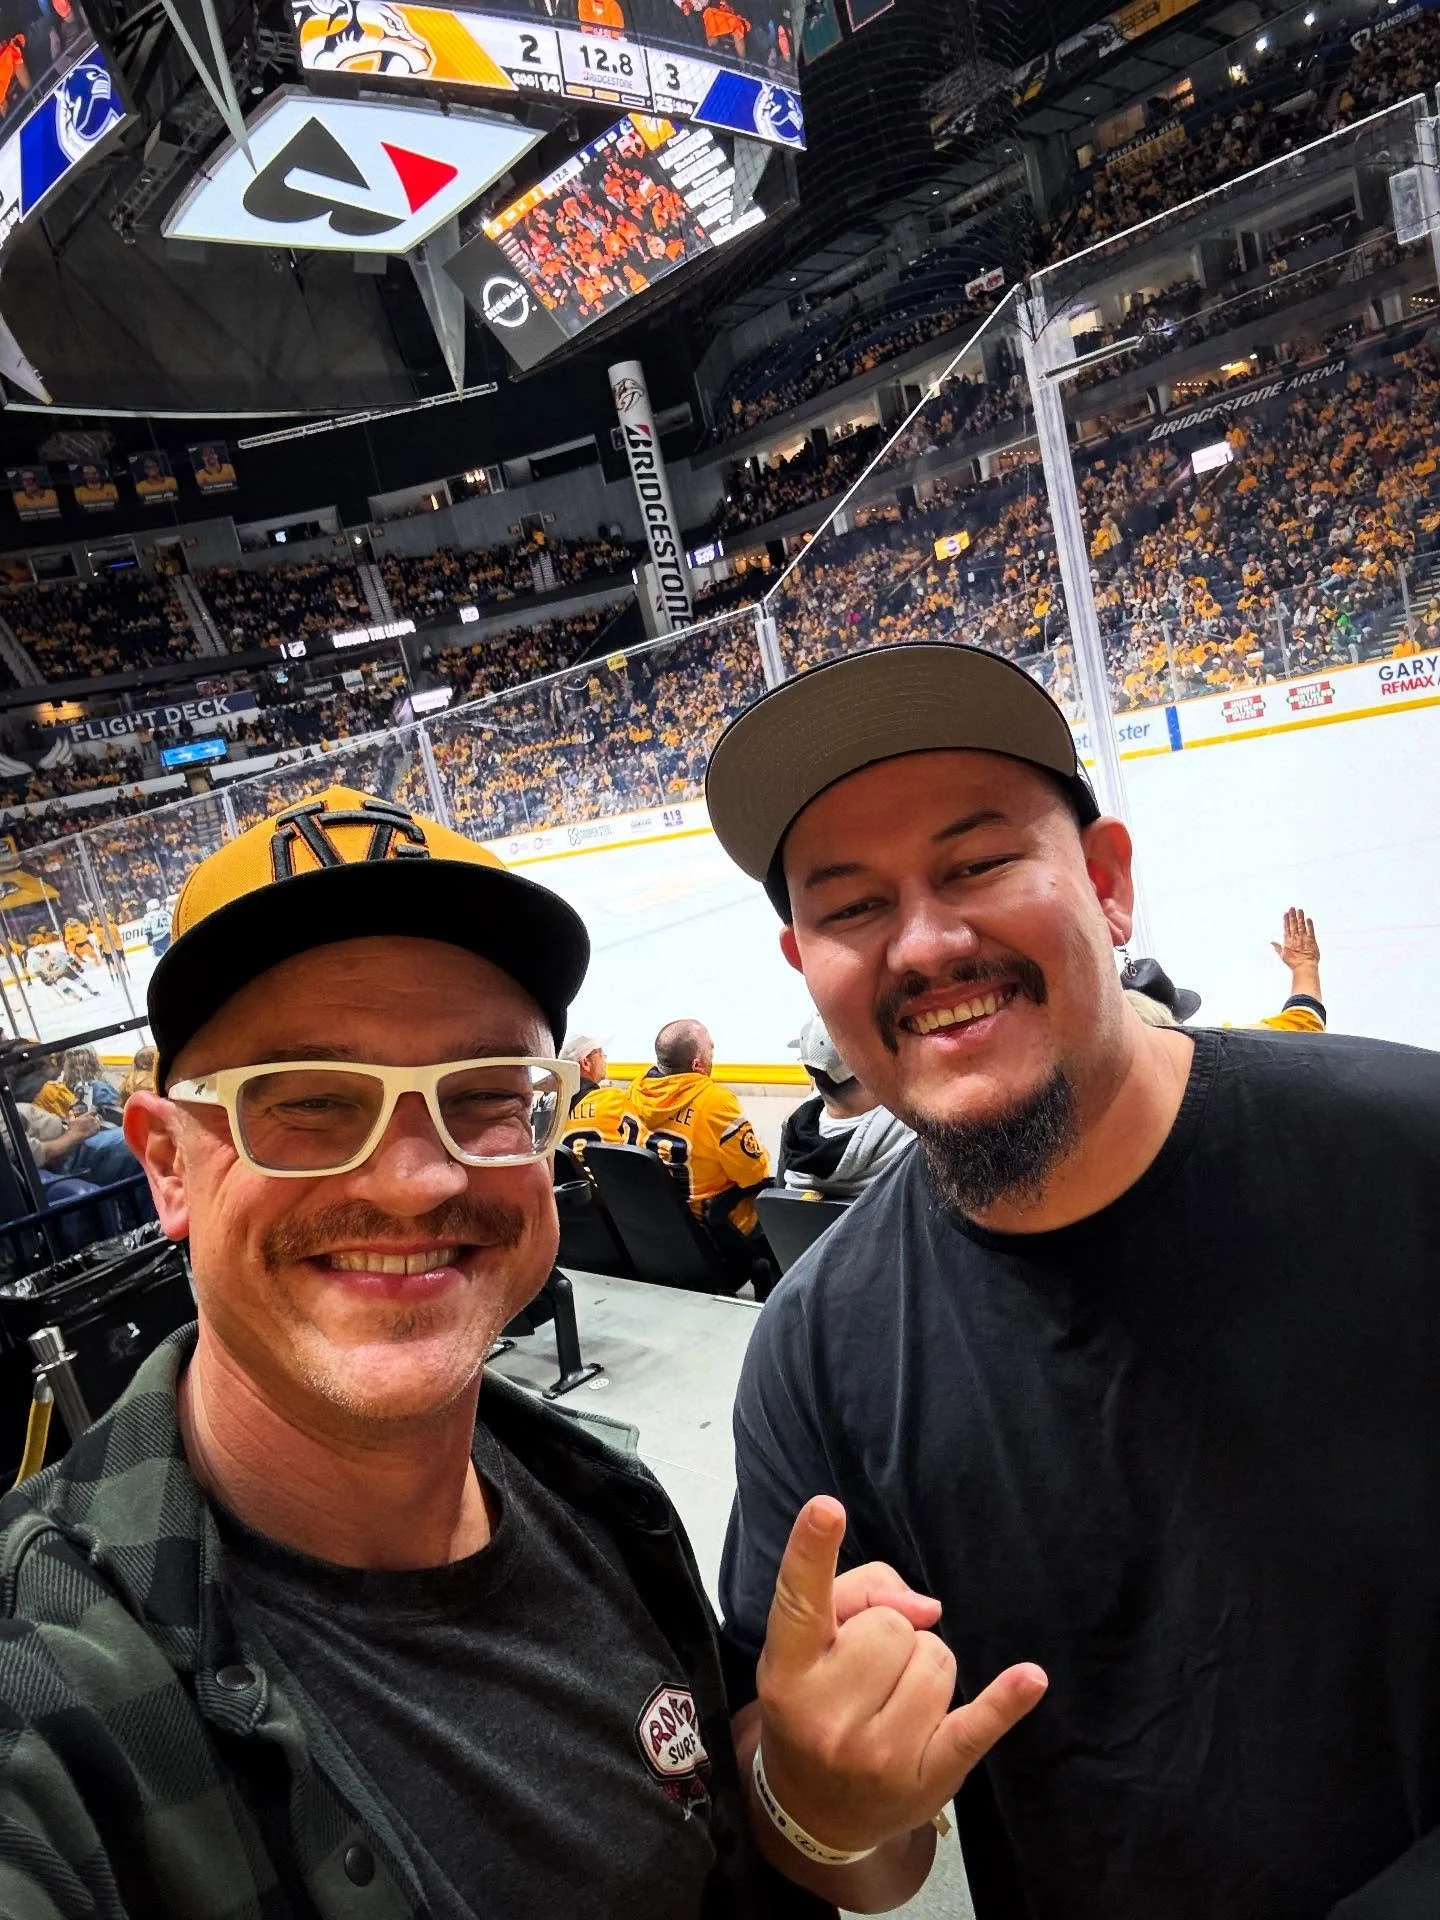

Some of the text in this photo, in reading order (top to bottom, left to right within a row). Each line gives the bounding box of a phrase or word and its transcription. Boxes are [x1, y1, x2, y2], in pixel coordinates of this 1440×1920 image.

[1375, 4, 1423, 33] FANDUEL
[519, 34, 542, 64] 2
[580, 45, 634, 76] 12.8
[582, 69, 633, 89] BRIDGESTONE
[664, 63, 681, 90] 3
[1148, 360, 1346, 442] BRIDGESTONE ARENA
[624, 424, 693, 630] BRIDGESTONE
[1379, 656, 1438, 681] GARY
[70, 697, 231, 743] FLIGHT DECK
[668, 1733, 696, 1765] SURF
